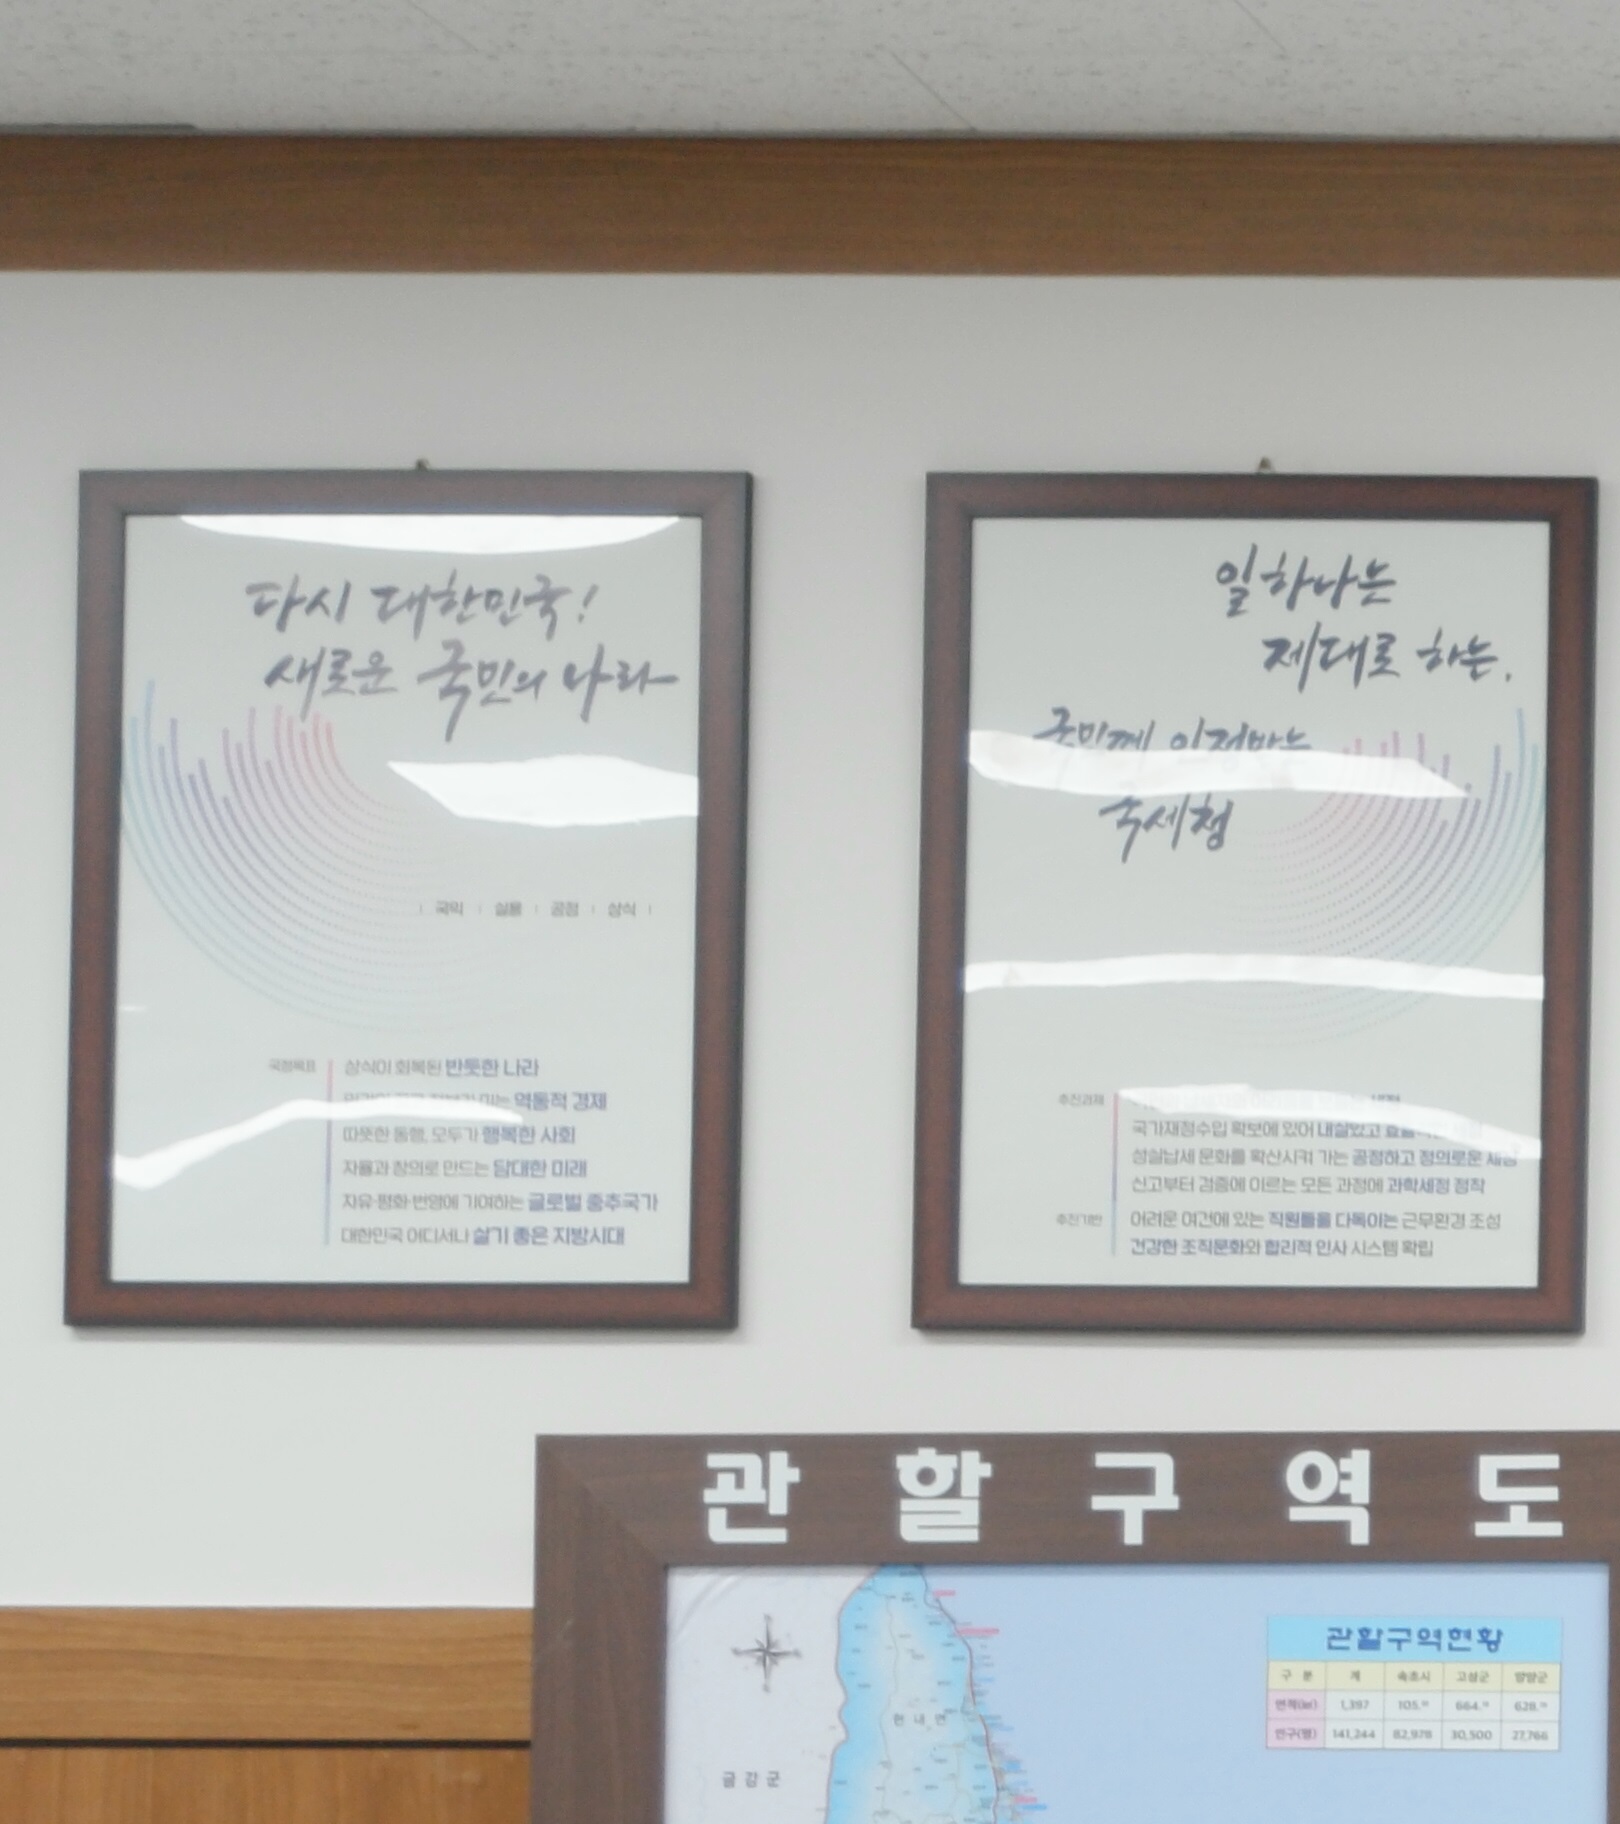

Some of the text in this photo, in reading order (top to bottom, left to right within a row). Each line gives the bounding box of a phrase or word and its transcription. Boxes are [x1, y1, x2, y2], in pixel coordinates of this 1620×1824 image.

[245, 568, 600, 641] 다시 대한민국!
[1261, 621, 1401, 693] 제대로
[264, 638, 679, 742] 새로운 국민의 나라
[345, 1058, 392, 1077] 상식이
[446, 1057, 499, 1077] 반듯한
[504, 1057, 539, 1077] 나라
[514, 1091, 568, 1111] 역동적
[572, 1091, 607, 1111] 경제
[343, 1126, 389, 1144] 따뜻한
[432, 1126, 478, 1144] 모두가
[482, 1125, 535, 1144] 행복한
[541, 1125, 576, 1144] 사회
[1231, 1120, 1278, 1138] 확보에
[1282, 1120, 1314, 1138] 있어
[1132, 1148, 1195, 1166] 성실납세
[1199, 1148, 1245, 1166] 문화를
[1250, 1148, 1313, 1166] 확산시켜
[1317, 1148, 1349, 1166] 가는
[1352, 1148, 1415, 1167] 공정하고
[1419, 1149, 1482, 1167] 정의로운
[393, 1159, 439, 1177] 창의로
[443, 1159, 489, 1177] 만드는
[493, 1159, 547, 1178] 담대한
[552, 1159, 587, 1178] 미래
[1132, 1176, 1486, 1195] 신고부터 검증에 이르는 모든 과정에 과학세정 정착
[463, 1193, 523, 1211] 기여하는
[528, 1192, 582, 1212] 글로벌
[587, 1192, 658, 1212] 중추국가
[1130, 1210, 1501, 1230] 어려운 여건에 있는 직원들을 다독이는 근무환경 조성
[341, 1226, 625, 1246] 대한민국 어디서나 살기 좋은 지방시대
[1130, 1238, 1434, 1257] 건강한 조직문화와 합리적 인사 시스템 확립
[1326, 1626, 1504, 1653] 관할구역현황
[1455, 1671, 1490, 1684] 고성군
[1332, 1729, 1377, 1742] 141,244
[1392, 1729, 1434, 1742] 82,978
[1452, 1729, 1493, 1742] 30,500
[1511, 1730, 1549, 1742] 27,766
